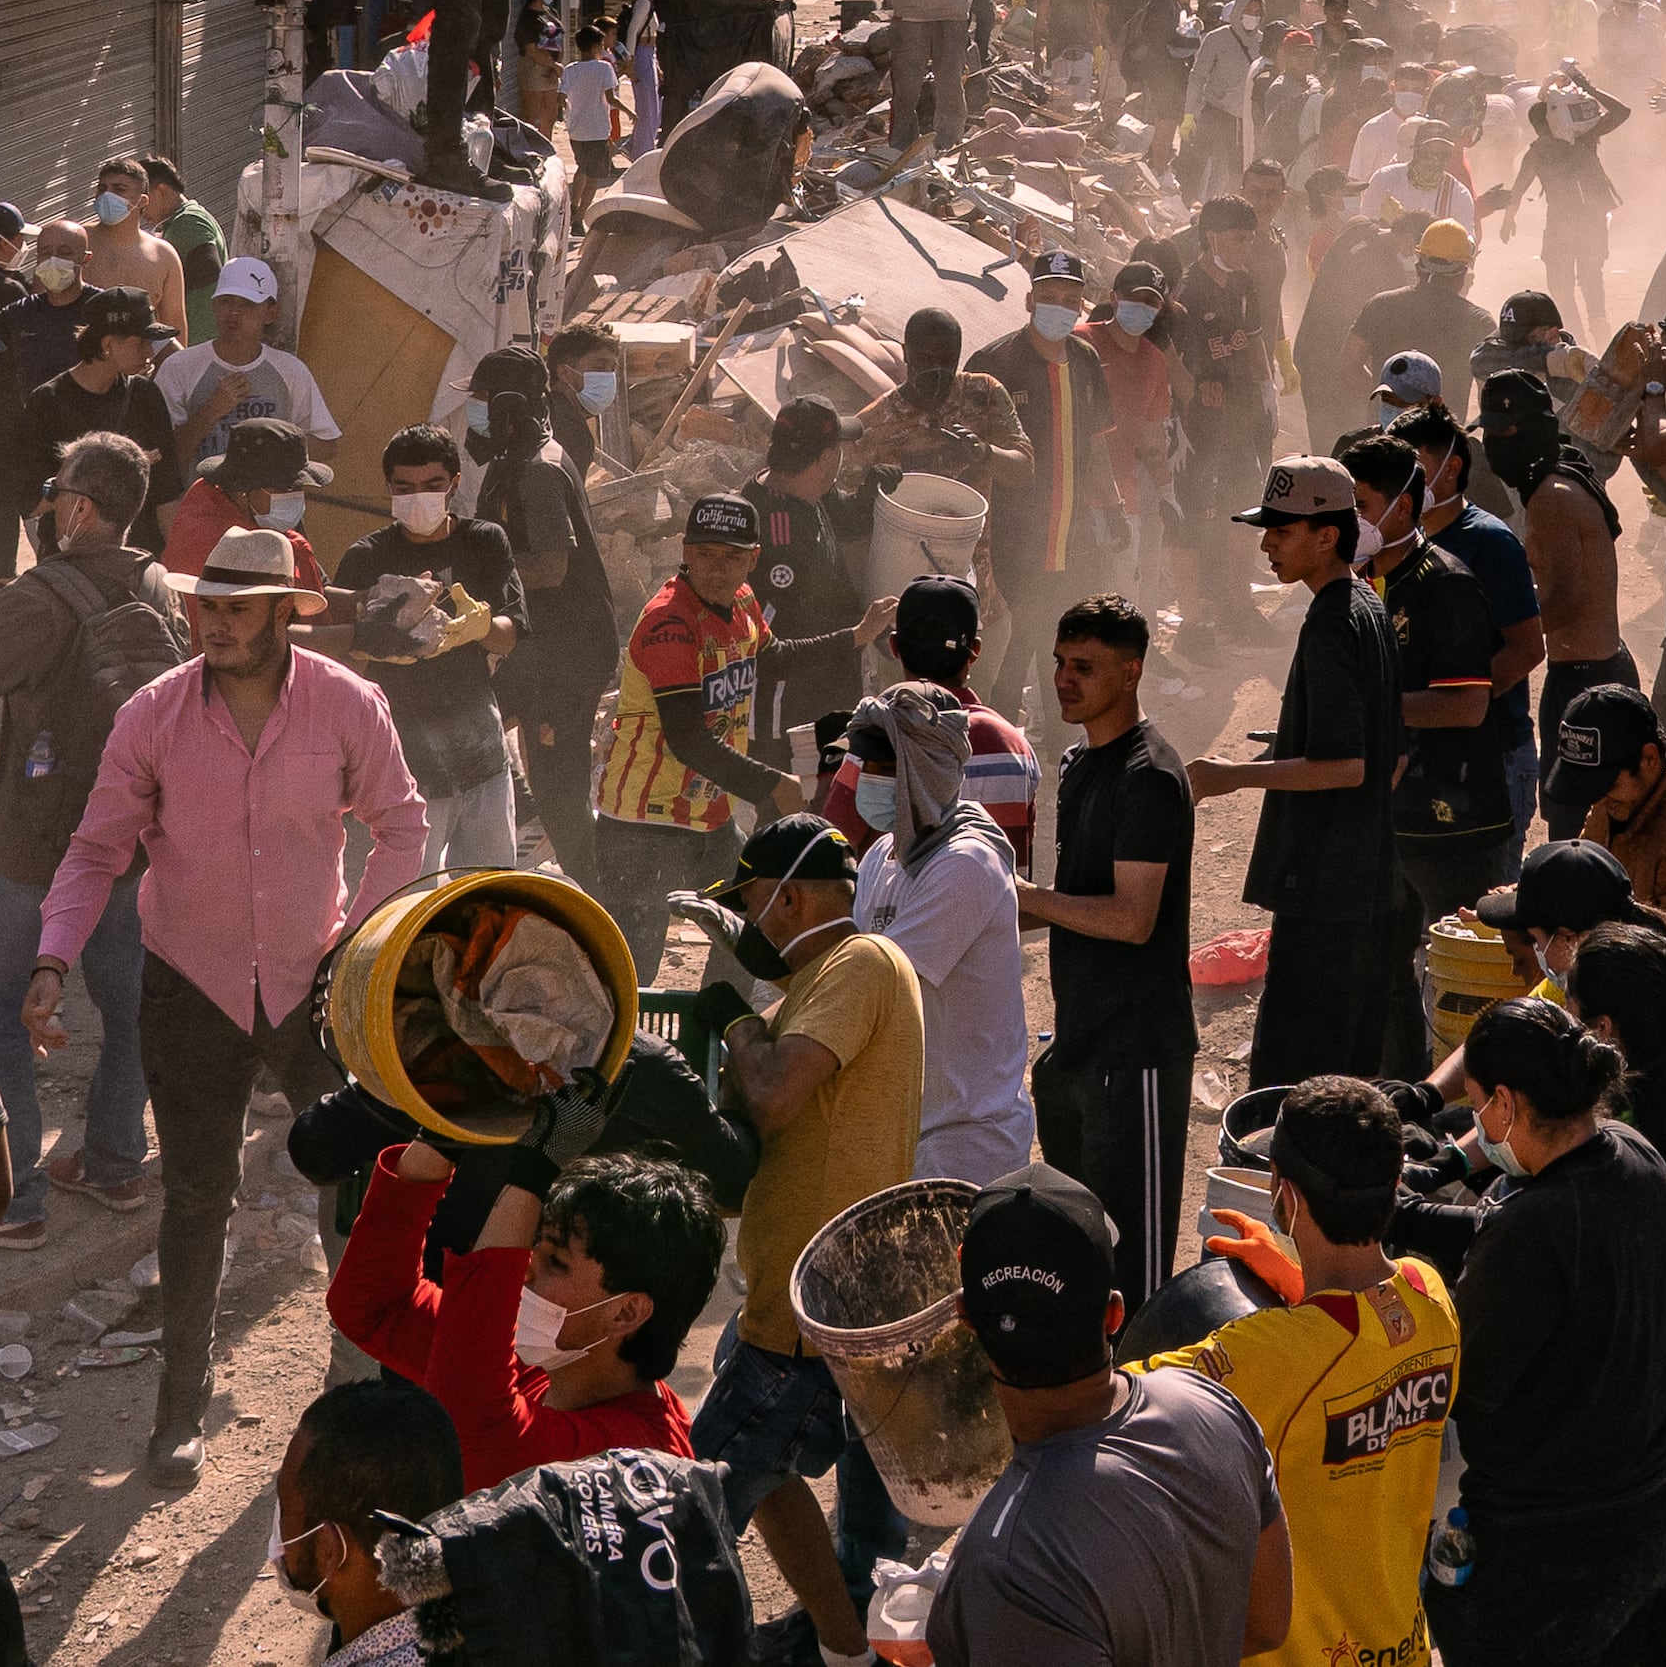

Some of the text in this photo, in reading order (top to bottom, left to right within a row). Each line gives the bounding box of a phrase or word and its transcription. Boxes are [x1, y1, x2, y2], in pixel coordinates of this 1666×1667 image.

[235, 400, 277, 419] HOP
[696, 508, 748, 529] California
[981, 1265, 1065, 1295] RECREACIÓN
[1372, 1354, 1435, 1397] AGUARDIENTE
[1347, 1372, 1448, 1447] BLANCO
[573, 1470, 603, 1554] COVERS
[594, 1471, 625, 1562] CAMERA
